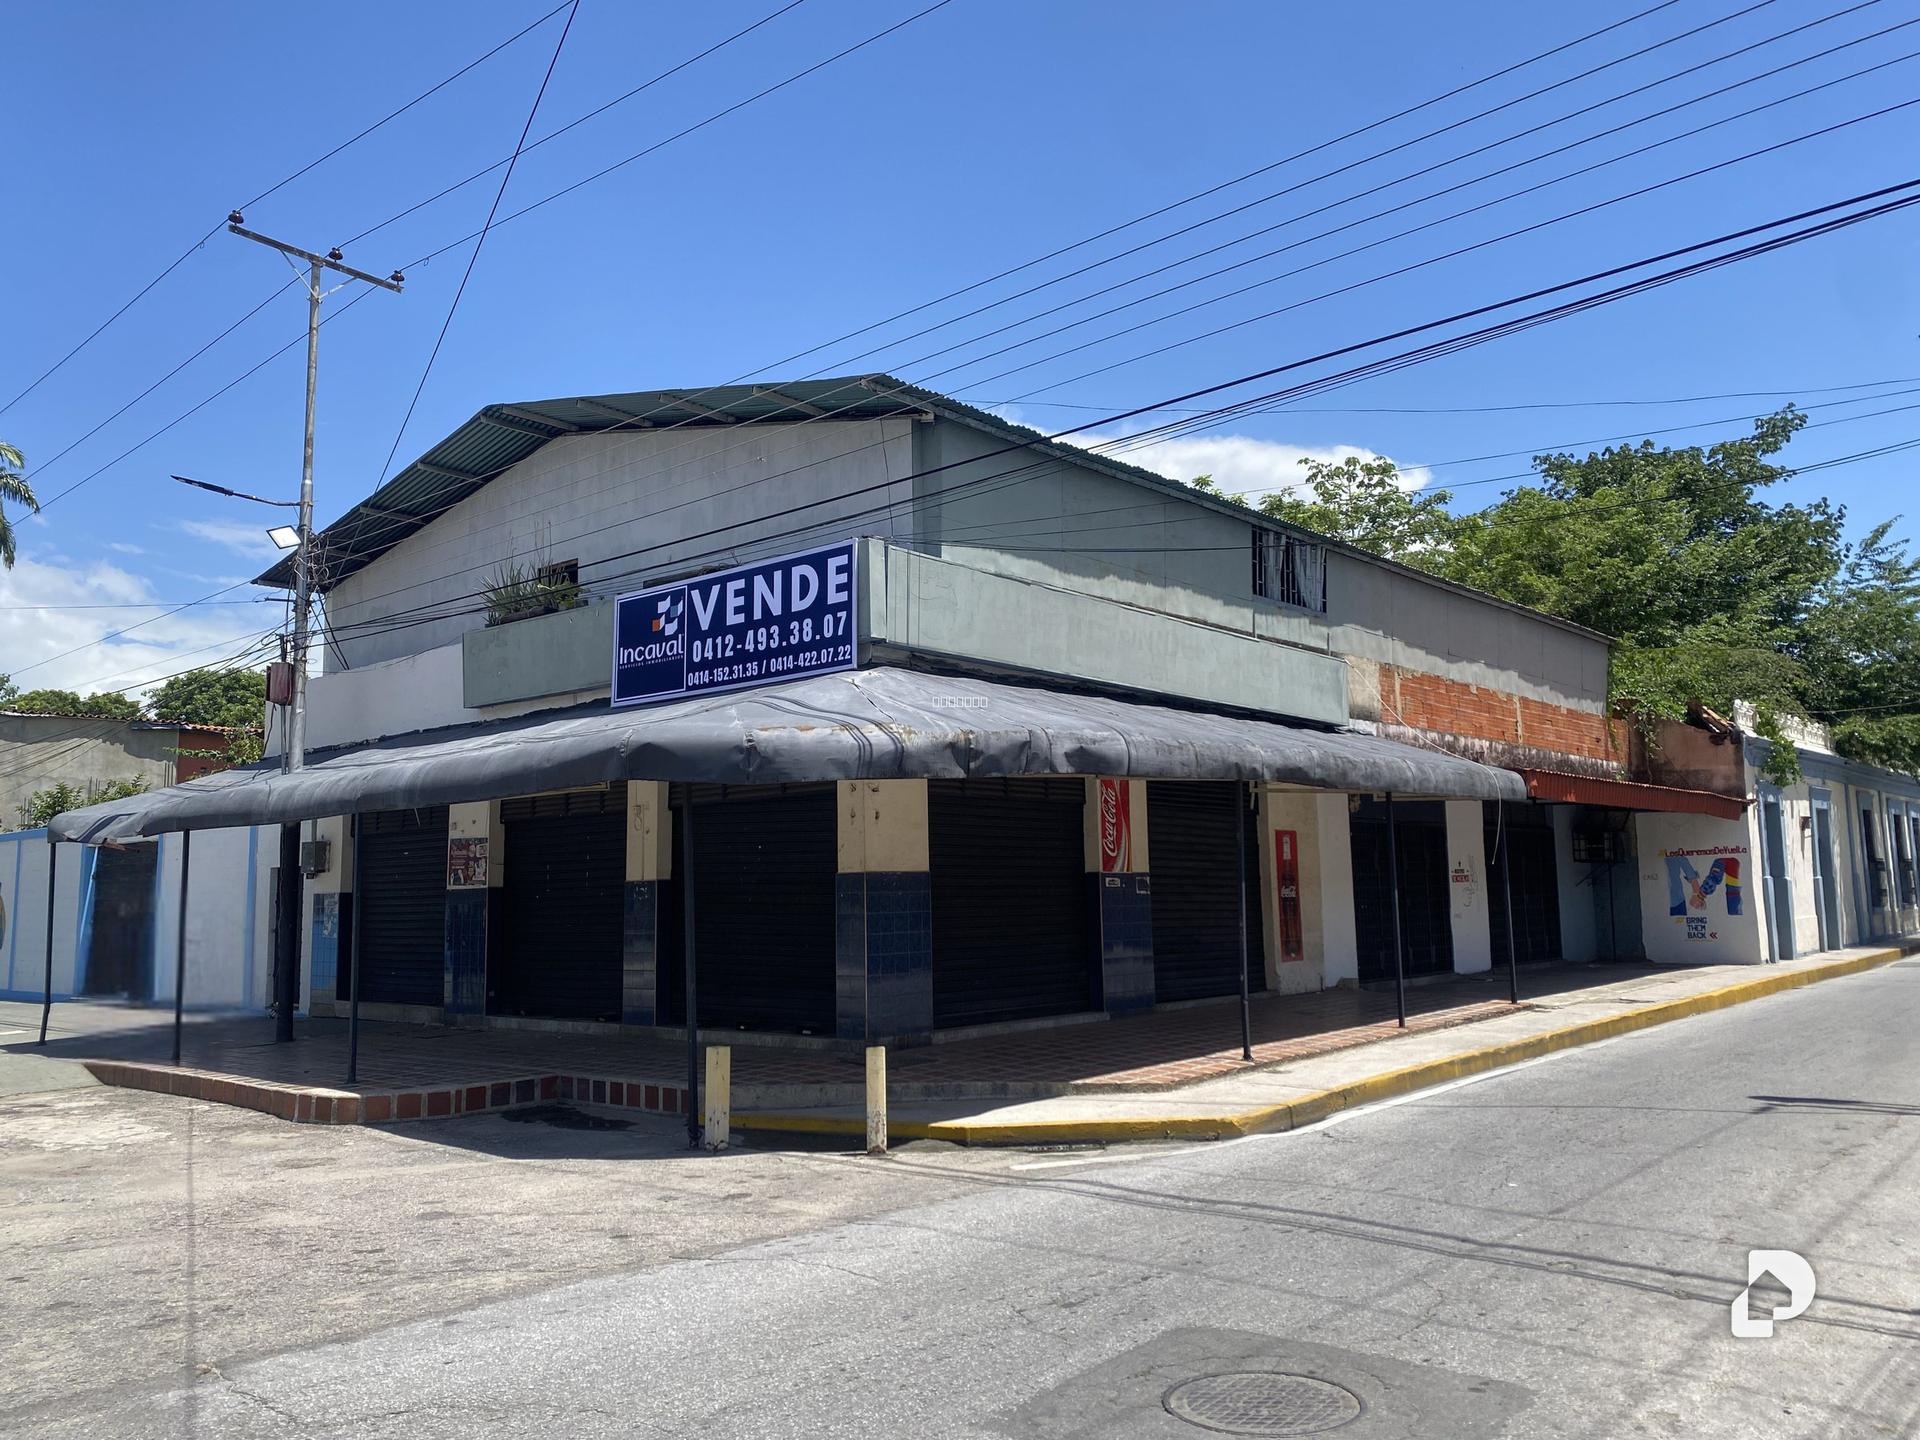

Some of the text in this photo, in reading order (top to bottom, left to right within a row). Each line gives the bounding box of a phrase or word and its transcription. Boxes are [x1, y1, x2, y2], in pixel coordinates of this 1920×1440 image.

[691, 554, 848, 631] VENDE
[619, 633, 684, 665] Incaval
[692, 611, 847, 663] 0412-493.38.07
[687, 662, 758, 687] 0414-152.31.35
[770, 645, 850, 673] 0414-422.07.22
